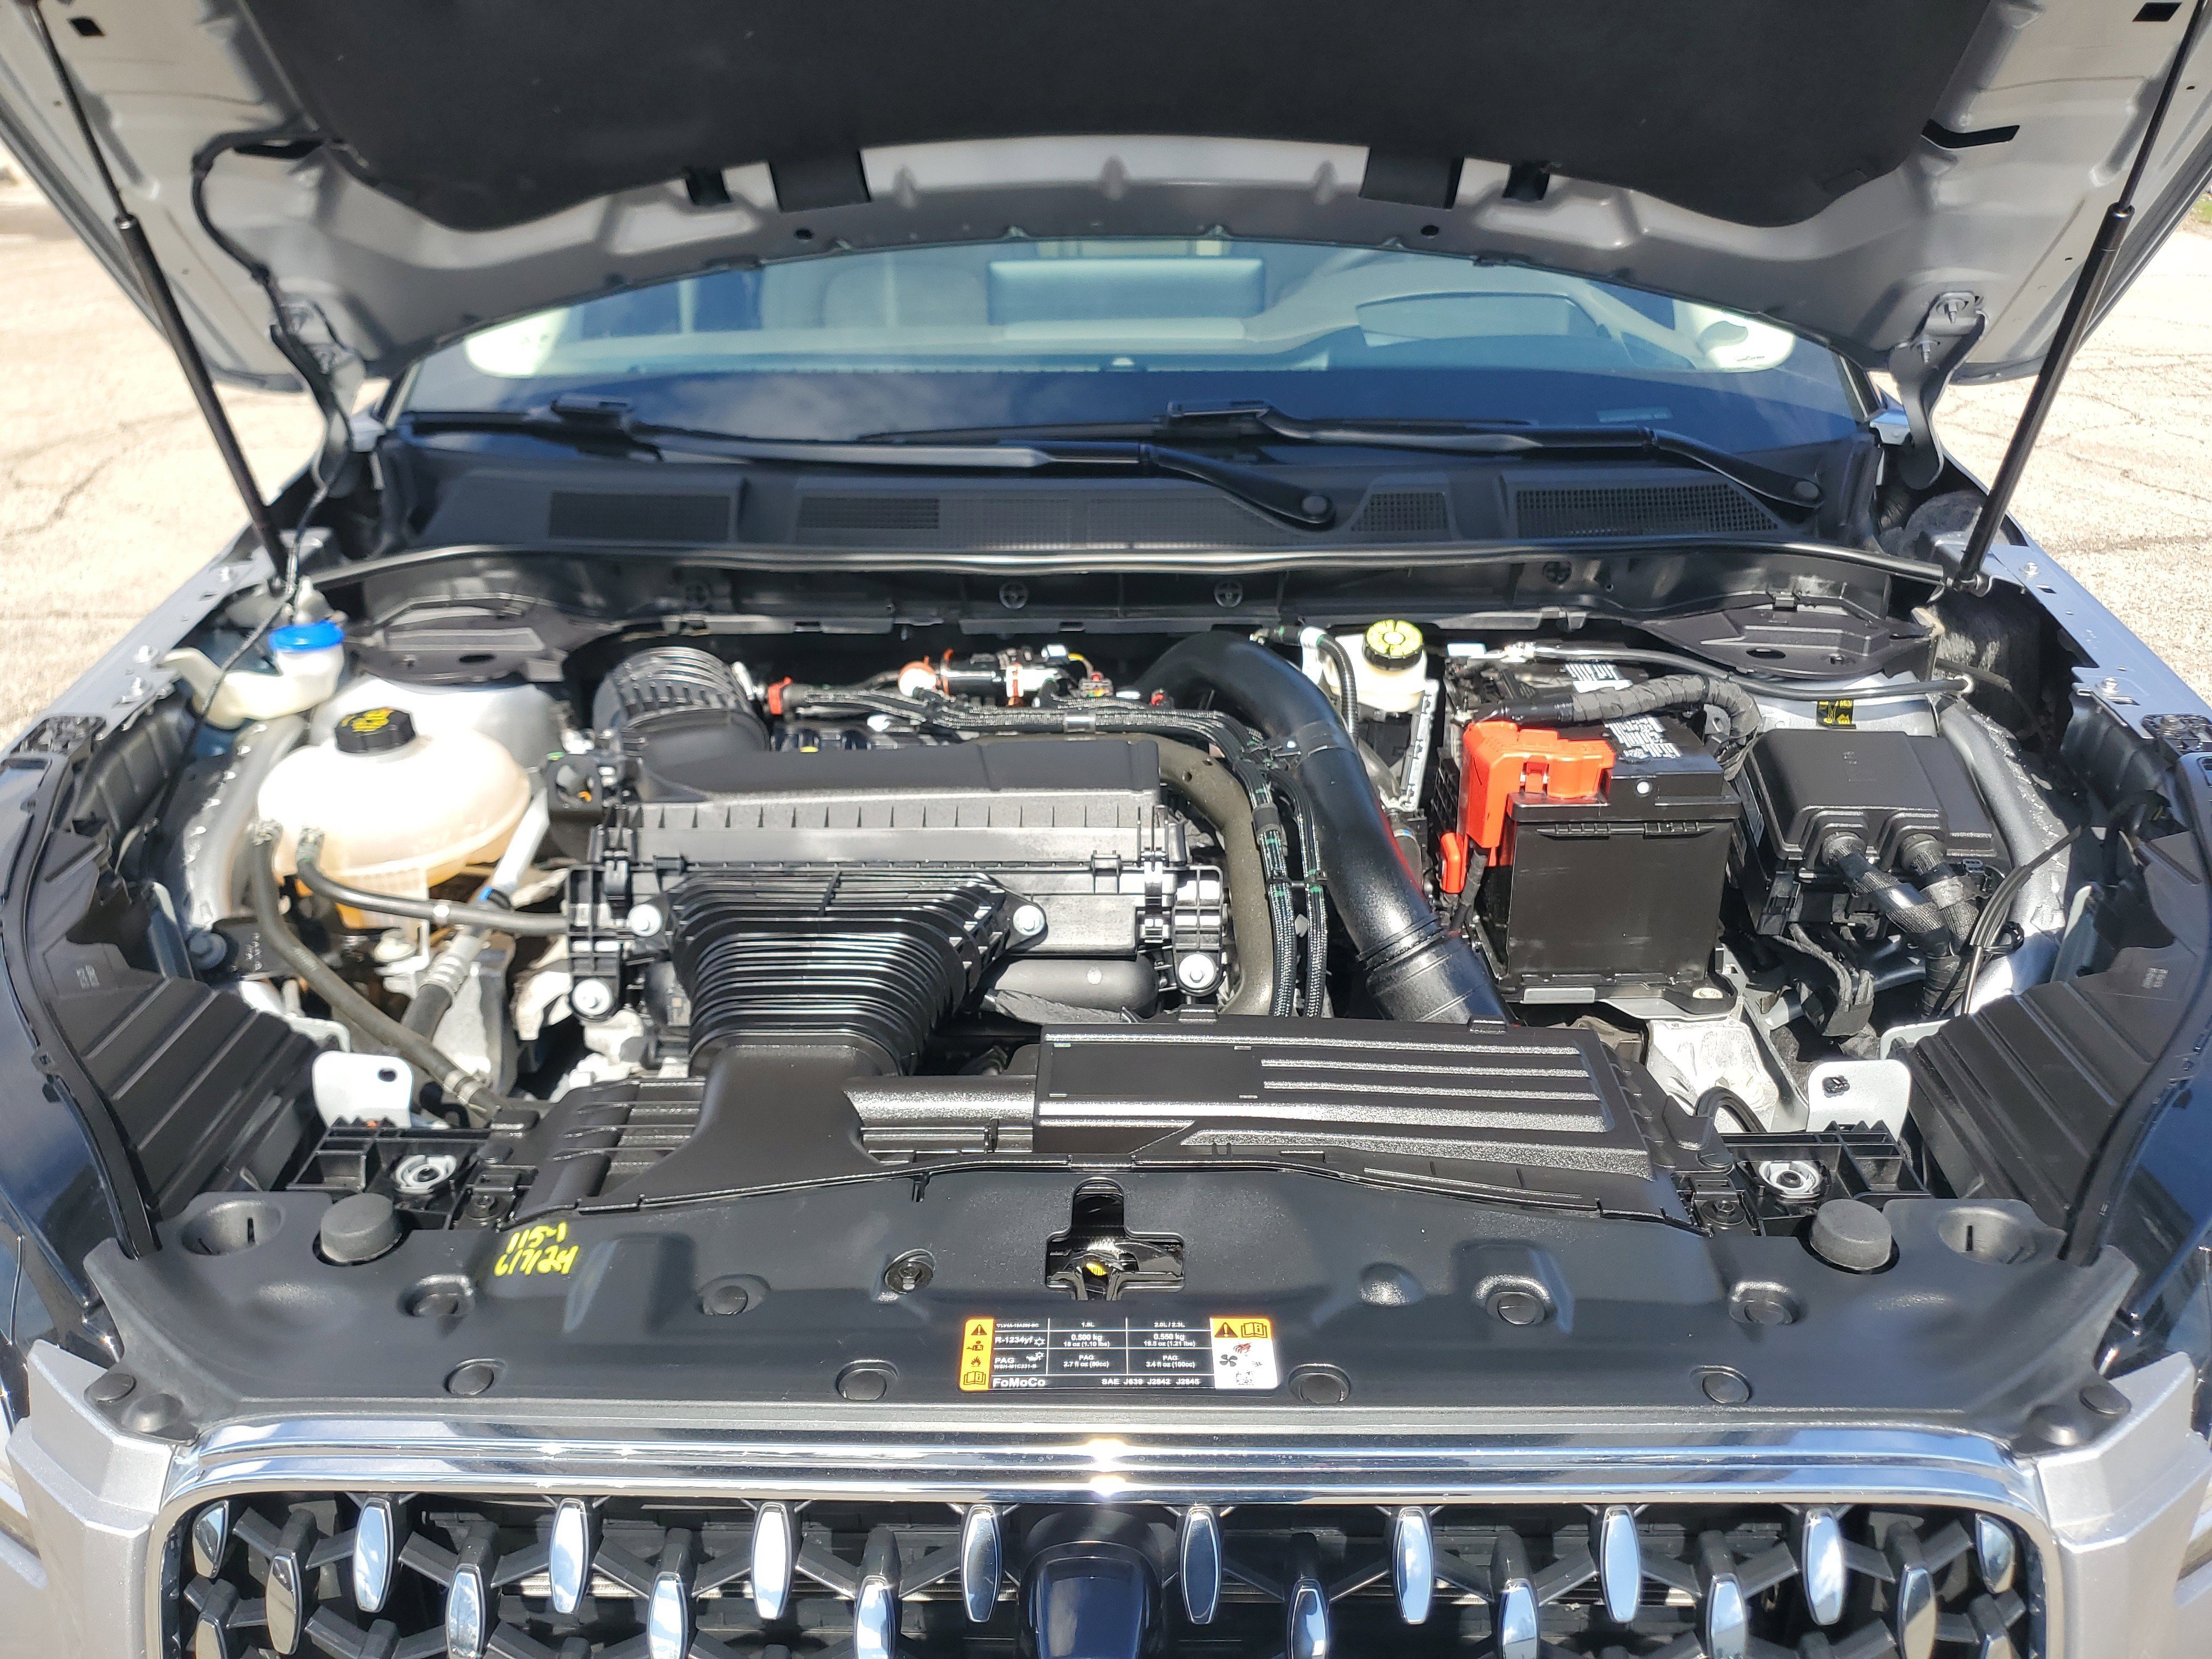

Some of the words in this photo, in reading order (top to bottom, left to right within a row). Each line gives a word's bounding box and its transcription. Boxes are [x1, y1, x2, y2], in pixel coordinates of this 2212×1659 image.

[994, 1336, 1034, 1345] R-1234yf
[1092, 1333, 1103, 1342] kg
[1175, 1333, 1186, 1341] kg
[992, 1377, 1046, 1389] FoMoCo
